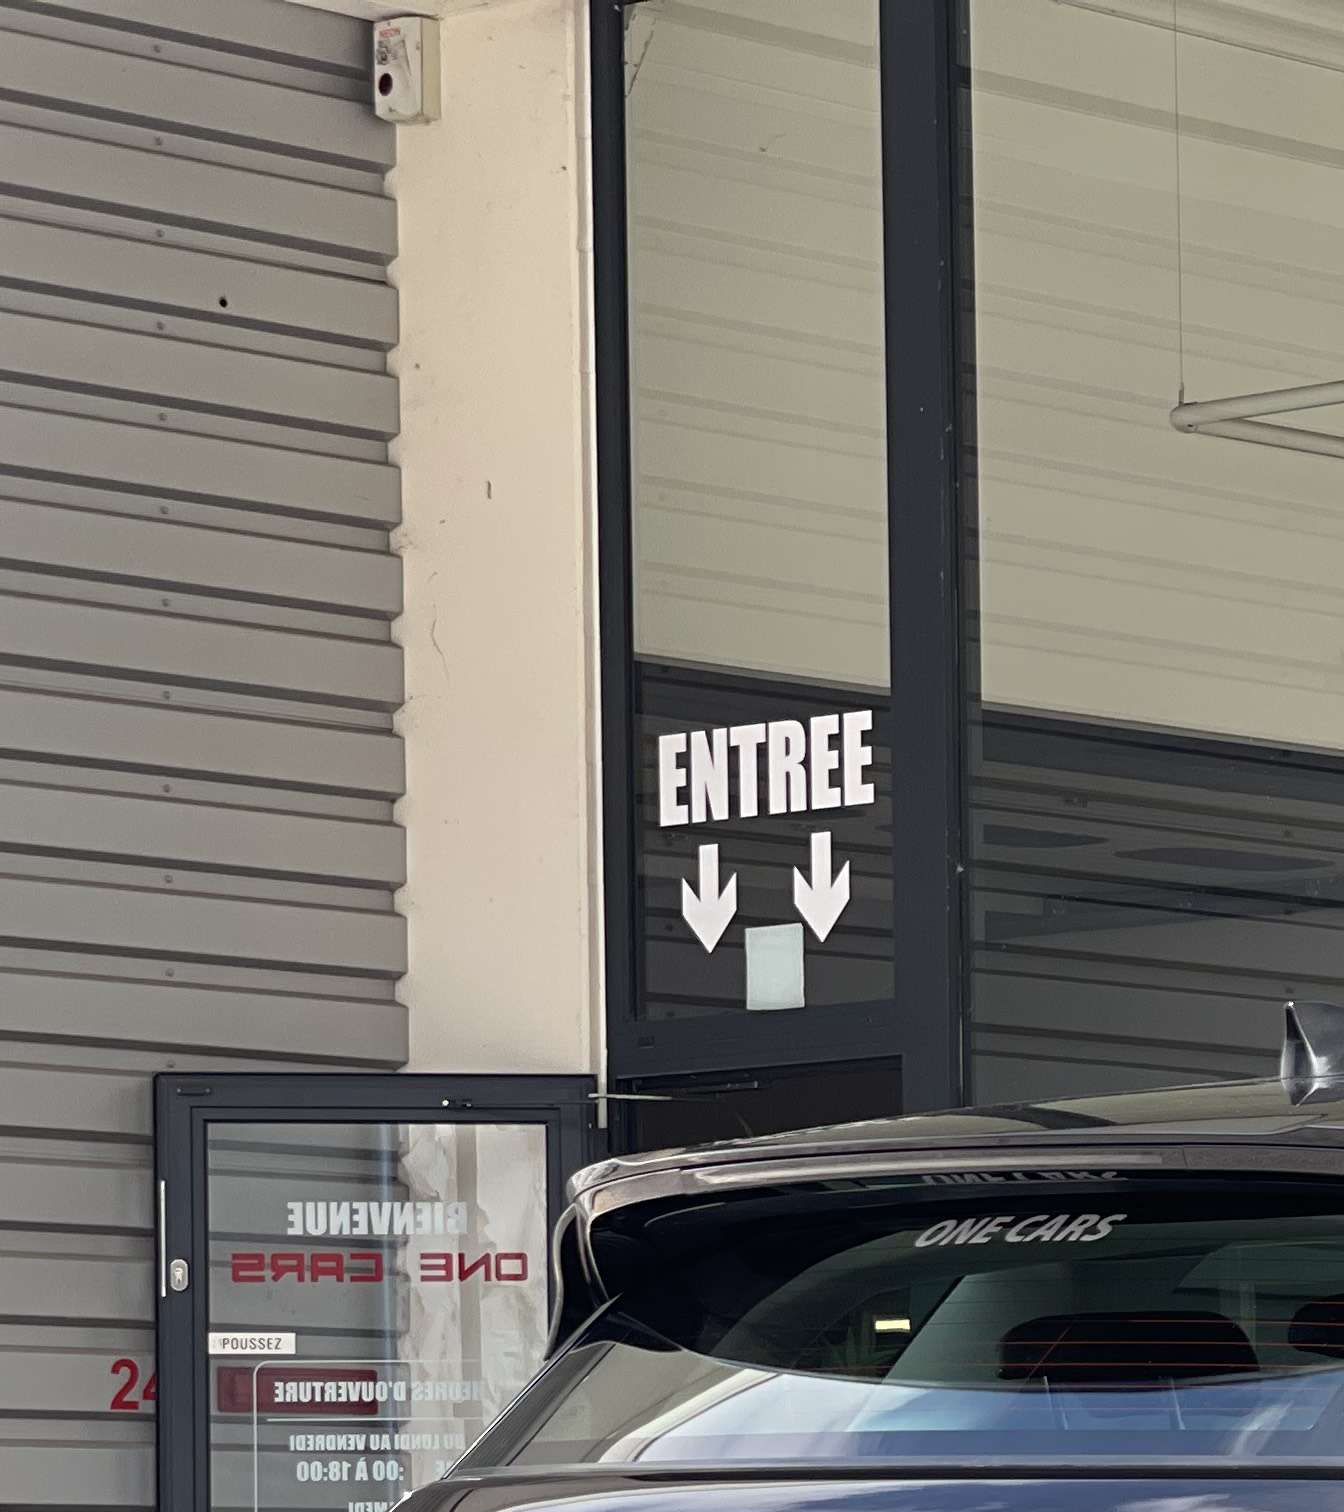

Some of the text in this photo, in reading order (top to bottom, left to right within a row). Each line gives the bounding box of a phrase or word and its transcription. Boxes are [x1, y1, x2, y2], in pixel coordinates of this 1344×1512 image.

[659, 709, 875, 827] ENTREE
[914, 1213, 1127, 1248] ONE CARS
[222, 1337, 282, 1350] POUSSEZ
